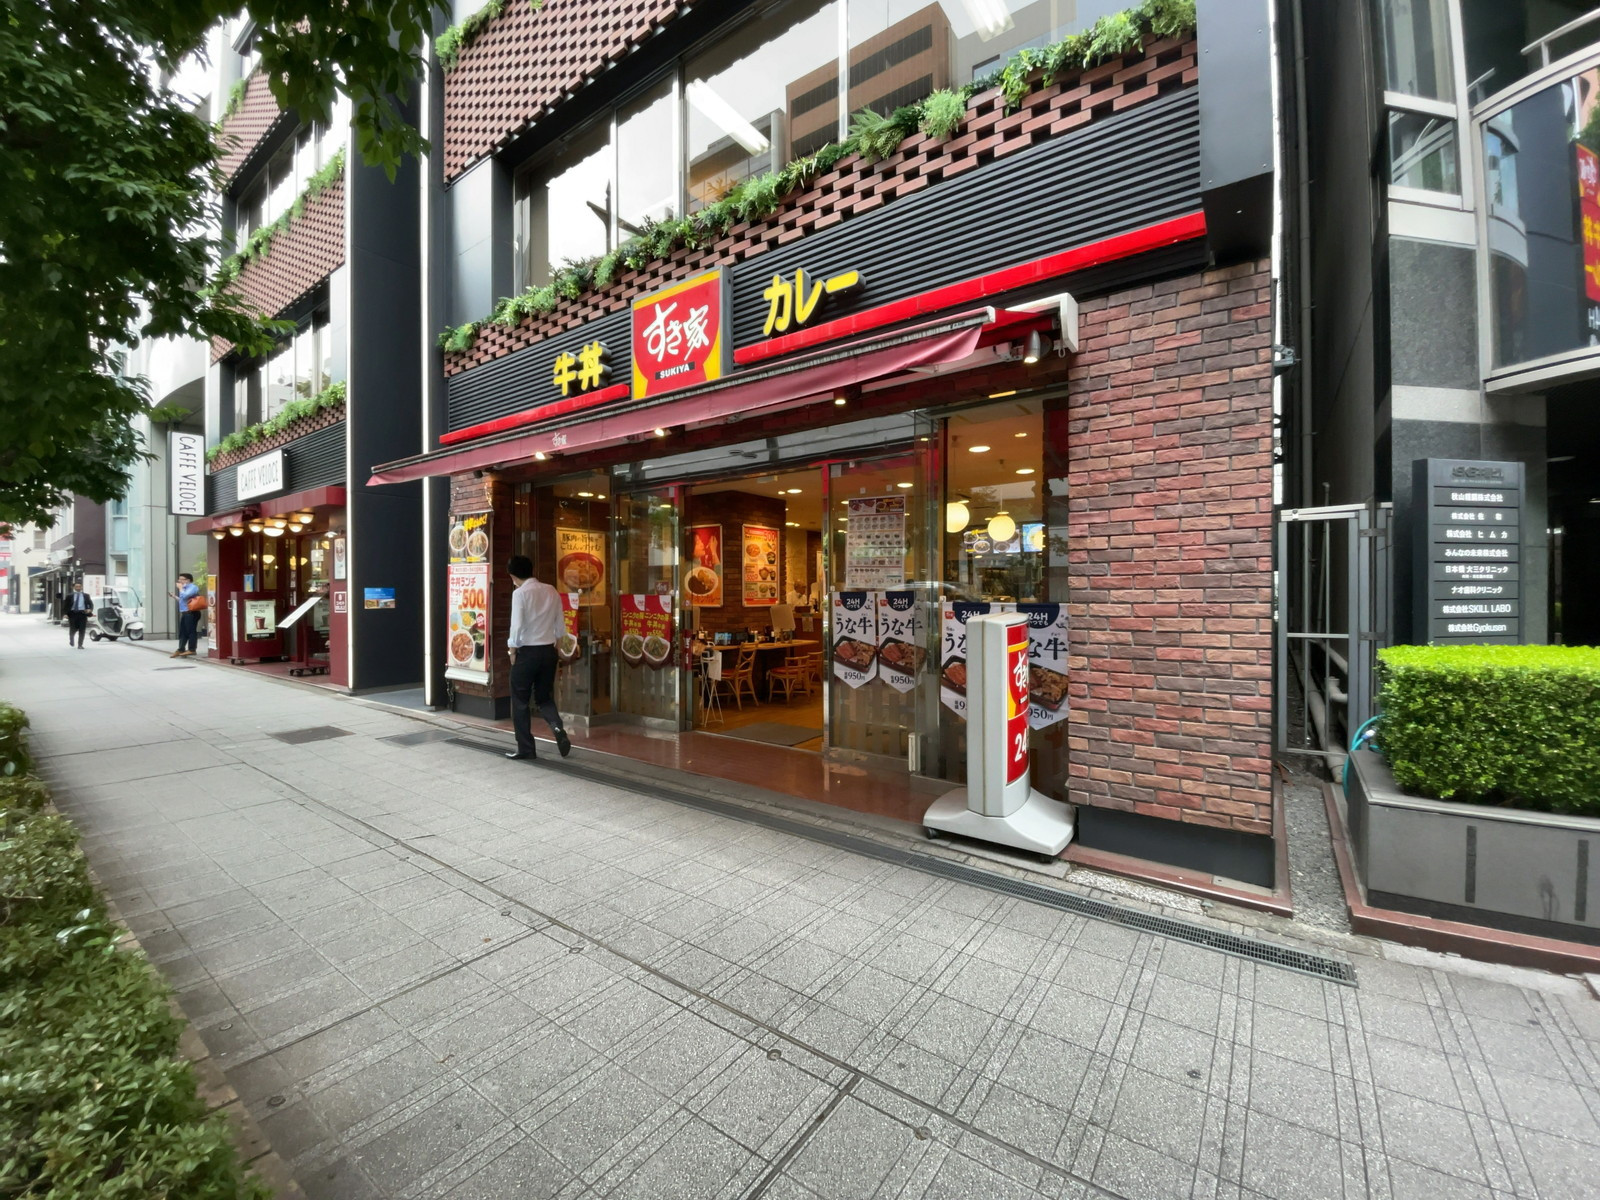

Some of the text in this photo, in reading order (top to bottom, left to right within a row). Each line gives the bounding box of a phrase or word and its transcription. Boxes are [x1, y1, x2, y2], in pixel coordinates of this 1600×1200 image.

[763, 268, 859, 336] カレー
[643, 302, 709, 362] すき家
[554, 341, 604, 396] 牛丼
[659, 363, 691, 379] SUKIYA
[179, 436, 196, 512] CAFFE VELOCE
[259, 460, 279, 487] VELOCE
[1446, 530, 1472, 538] 株式会社
[1490, 604, 1511, 613] LABO
[835, 616, 873, 635] うな牛
[881, 617, 923, 636] うな牛
